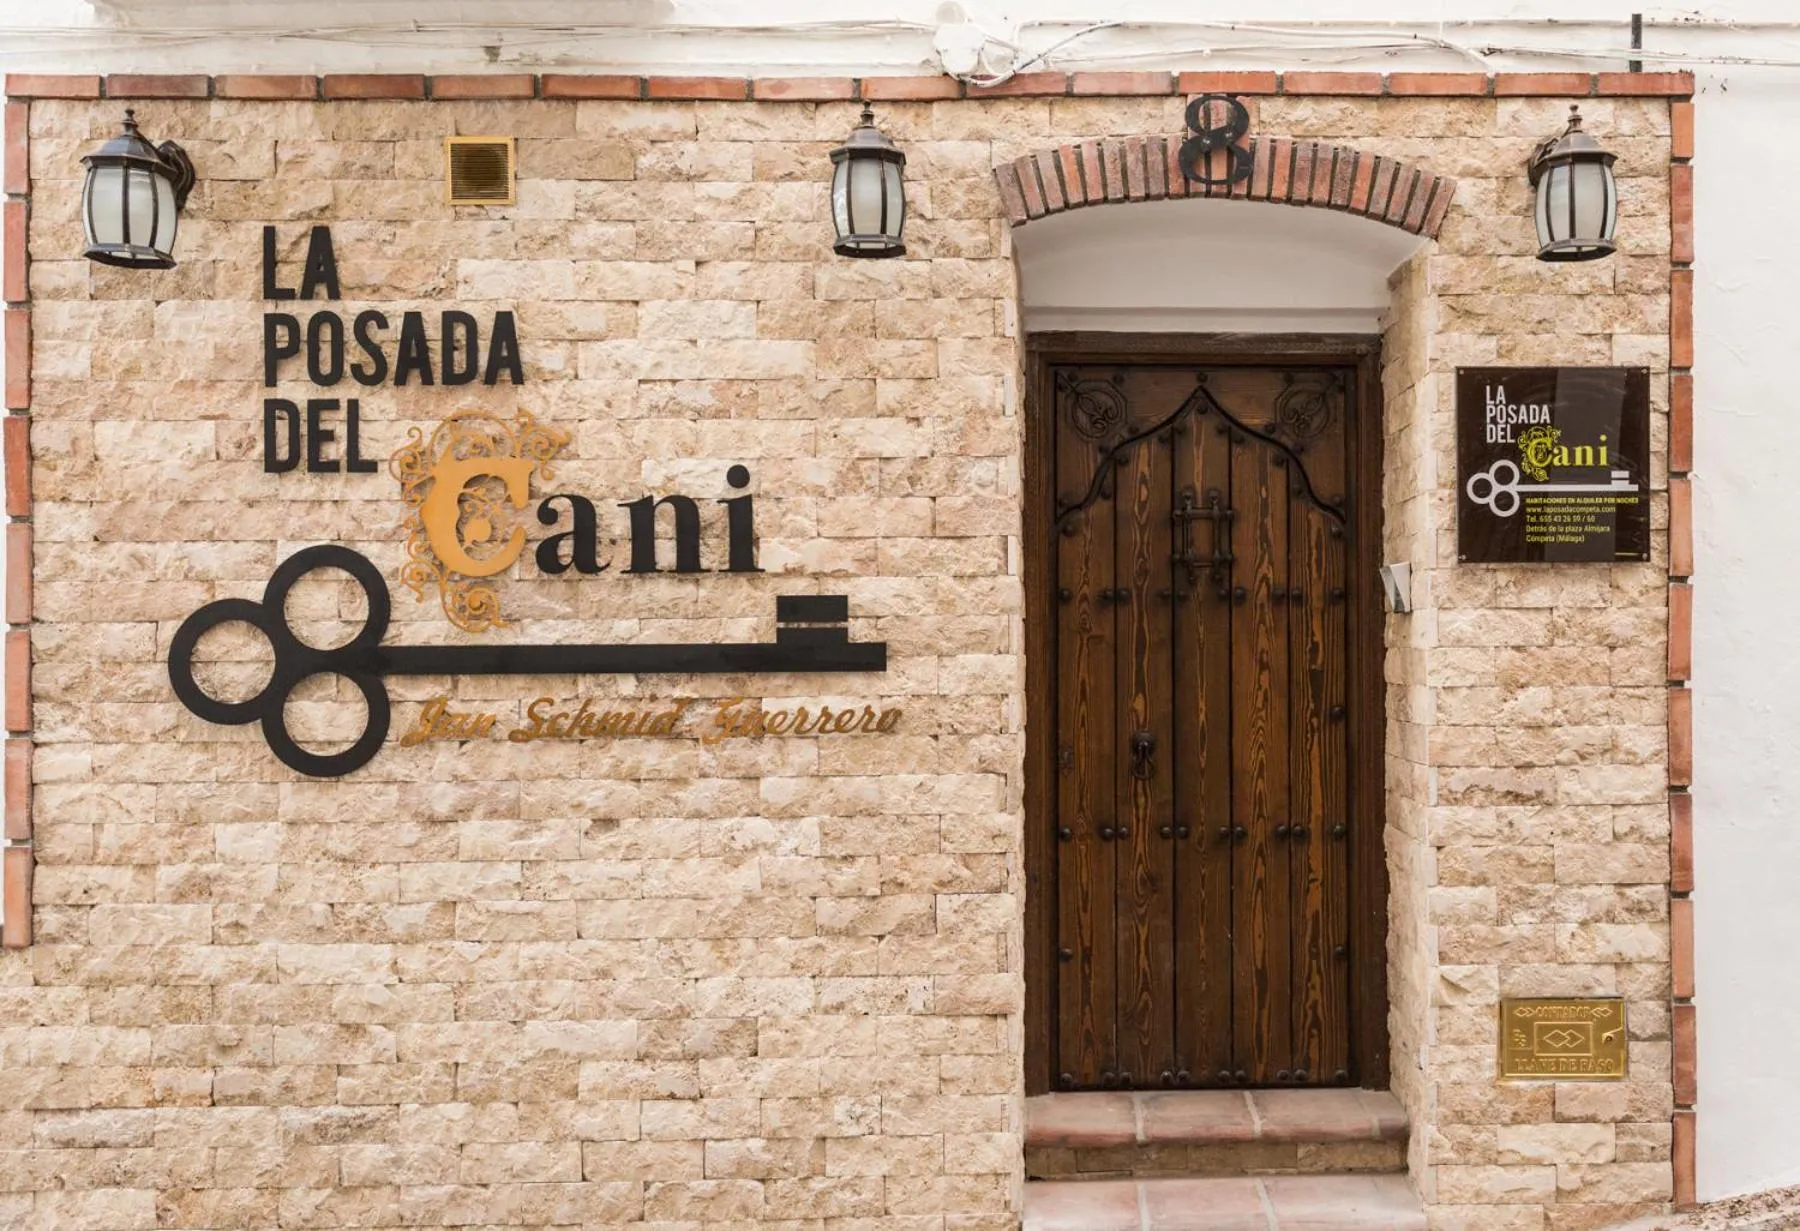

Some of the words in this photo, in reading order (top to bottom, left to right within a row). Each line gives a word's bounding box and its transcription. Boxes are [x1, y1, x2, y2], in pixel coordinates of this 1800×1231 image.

[1179, 96, 1252, 185] 8
[263, 226, 341, 300] LA
[263, 310, 524, 388] POSADA
[1486, 385, 1506, 404] LA
[1486, 404, 1551, 424] POSADA
[263, 398, 378, 473] DEL
[1486, 424, 1516, 443] DEL
[1522, 430, 1609, 472] Cani
[400, 440, 765, 590] Cani
[1565, 525, 1582, 533] plaza
[508, 697, 697, 743] Schmid
[701, 695, 902, 745] Guerrero
[1559, 1058, 1578, 1073] DE
